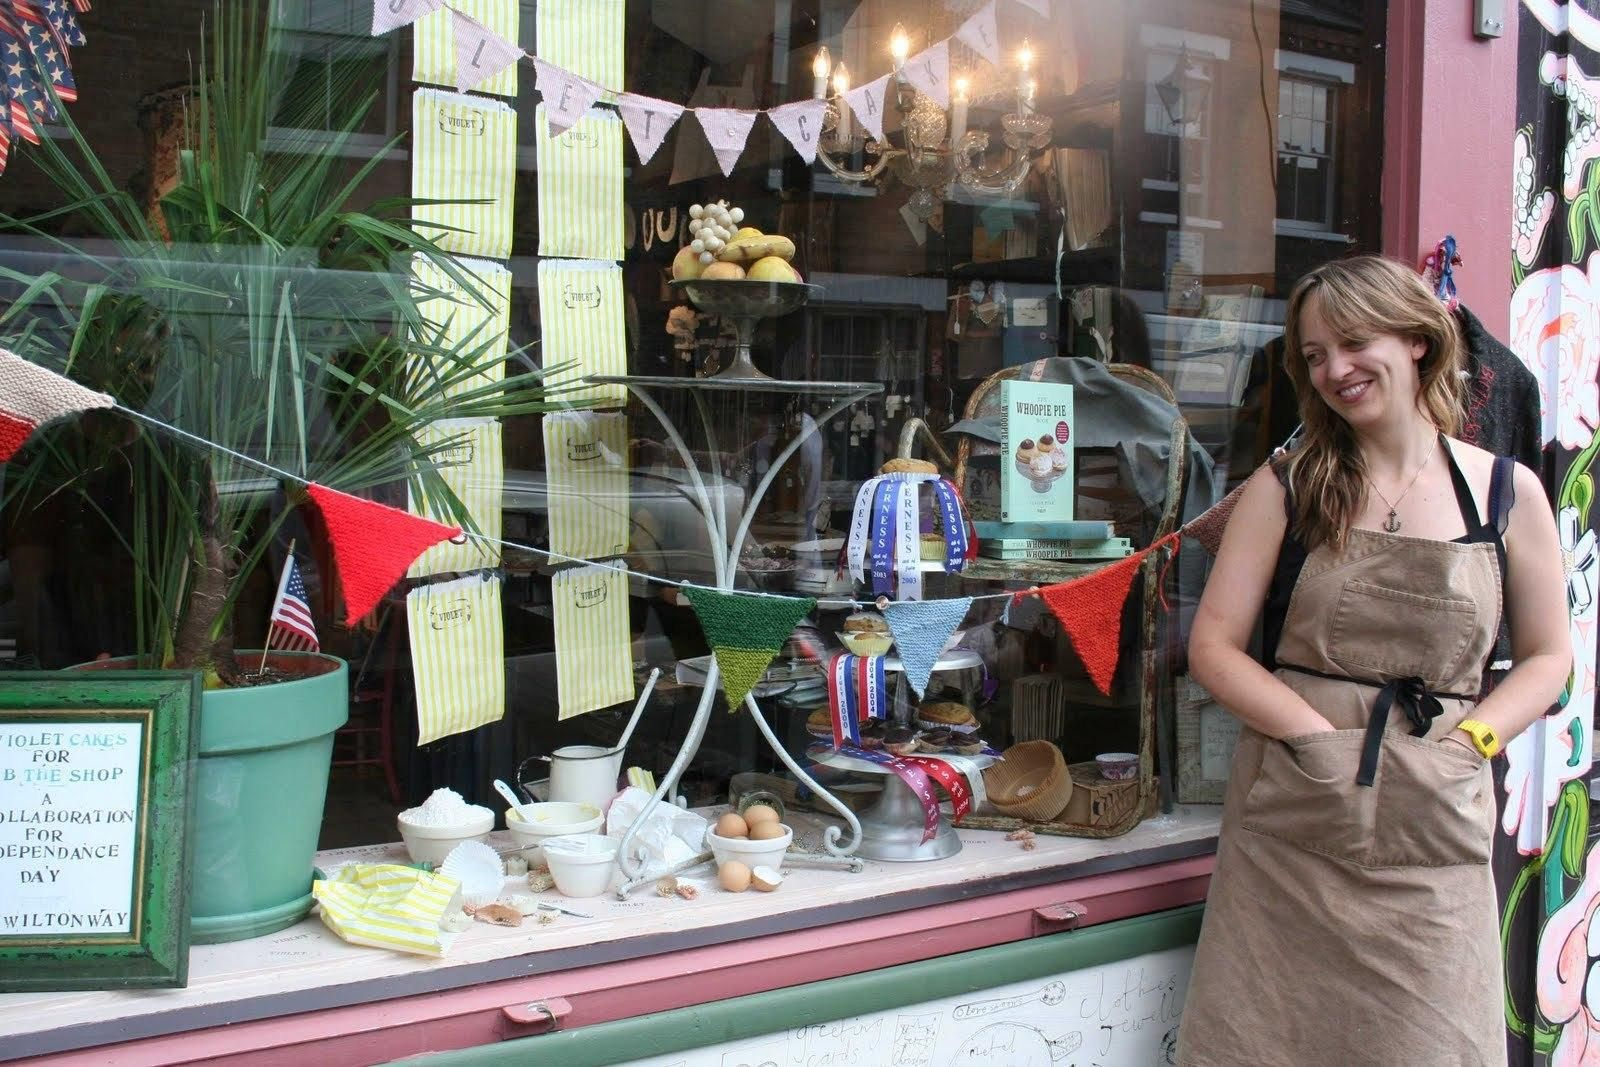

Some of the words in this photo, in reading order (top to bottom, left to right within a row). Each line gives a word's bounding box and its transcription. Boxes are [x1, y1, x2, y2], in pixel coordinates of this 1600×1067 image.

[448, 116, 476, 129] VIOLET
[571, 292, 593, 302] VIOLET
[1016, 402, 1052, 417] WHOOPIE
[1053, 404, 1067, 417] PIE
[1001, 405, 1009, 440] WHOOPIE
[574, 443, 596, 453] VIOLET
[1001, 442, 1009, 456] PIE
[1026, 540, 1058, 549] WHOOPIE
[1060, 540, 1072, 548] PIE
[1026, 550, 1058, 559] WHOOPIE
[1060, 550, 1072, 558] PIE
[580, 587, 602, 601] VIOLET
[438, 608, 463, 621] VIOLET
[840, 700, 849, 729] 2000
[69, 733, 128, 748] CAKES
[32, 750, 70, 763] FOR
[24, 768, 61, 783] THE
[69, 767, 124, 782] SHOP
[41, 792, 53, 806] A
[25, 828, 63, 843] FOR
[20, 869, 61, 884] DAY
